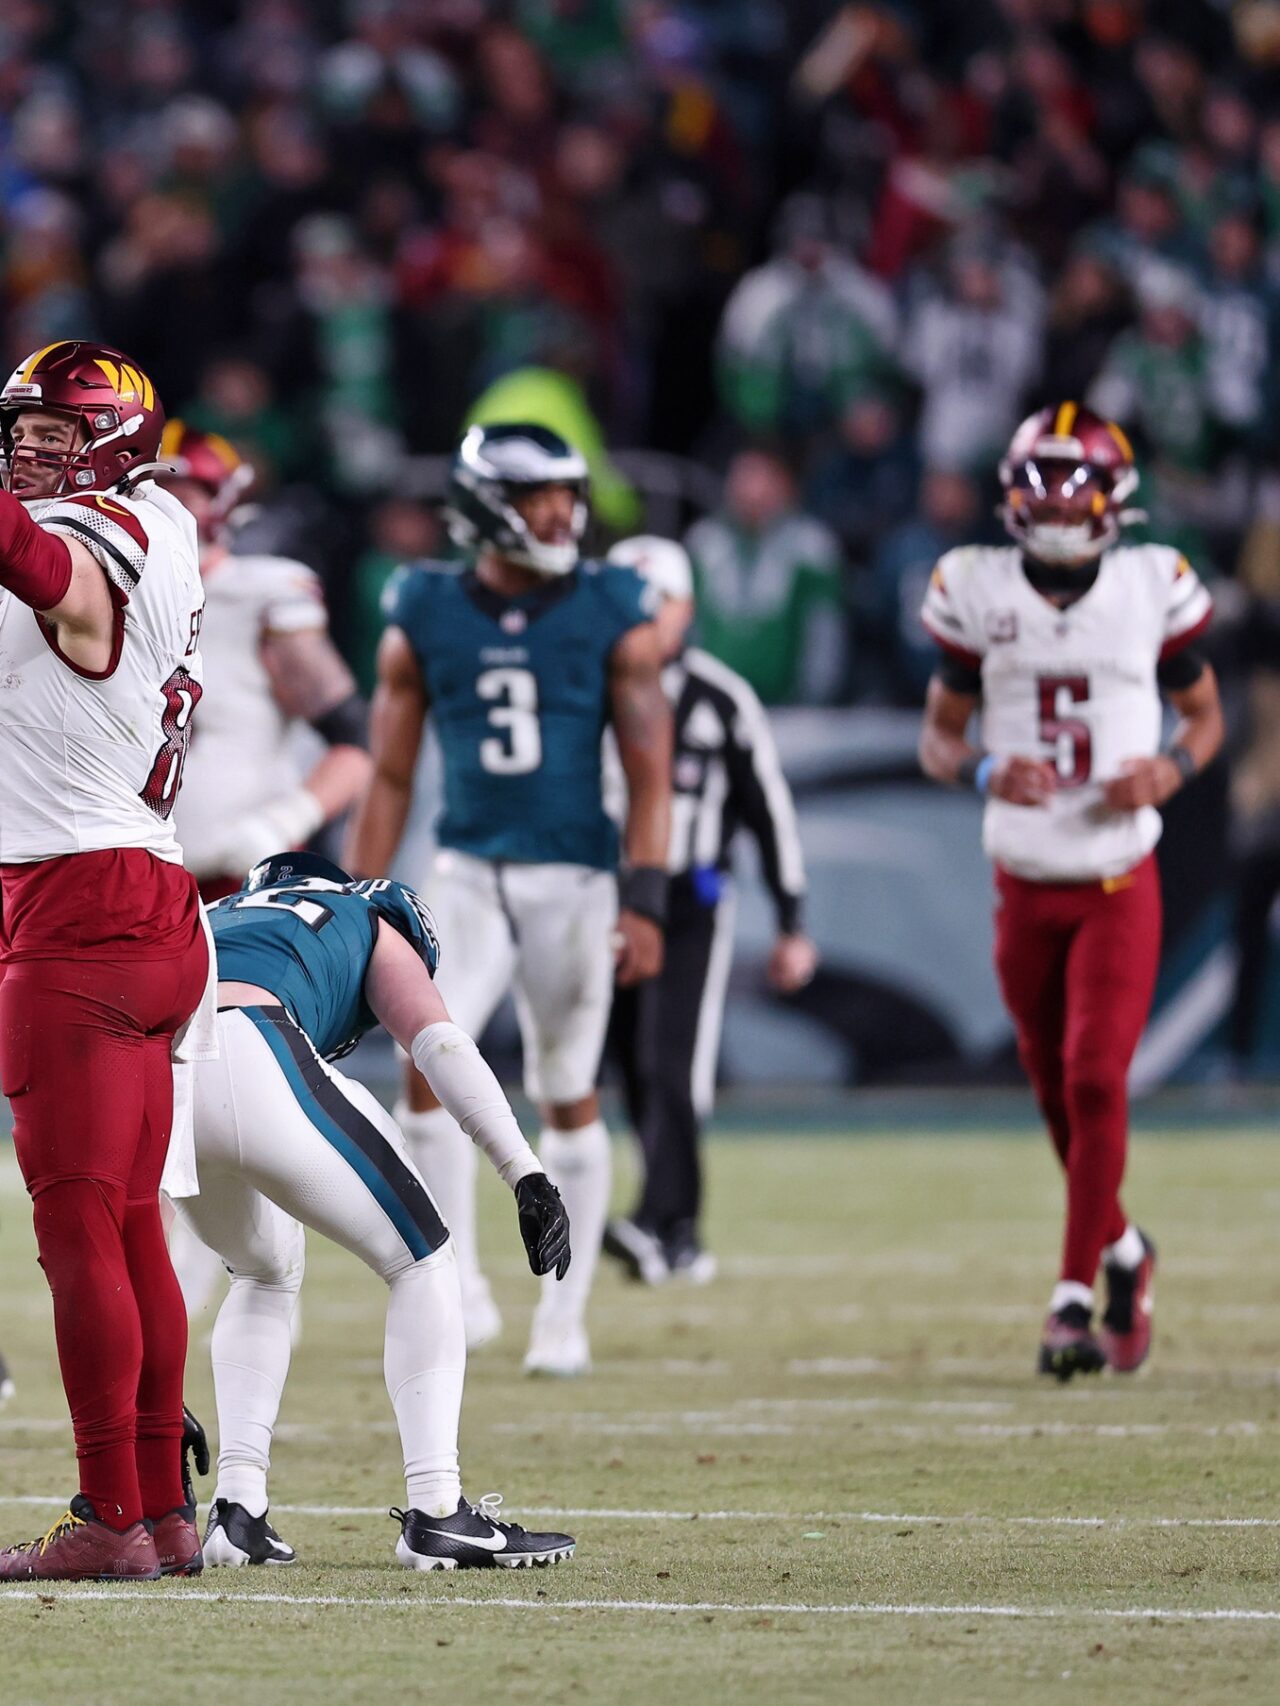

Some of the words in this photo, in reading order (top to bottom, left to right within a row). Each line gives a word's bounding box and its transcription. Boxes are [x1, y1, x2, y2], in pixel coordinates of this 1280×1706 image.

[138, 665, 203, 821] 8
[475, 666, 542, 775] 3
[1036, 672, 1093, 788] 5
